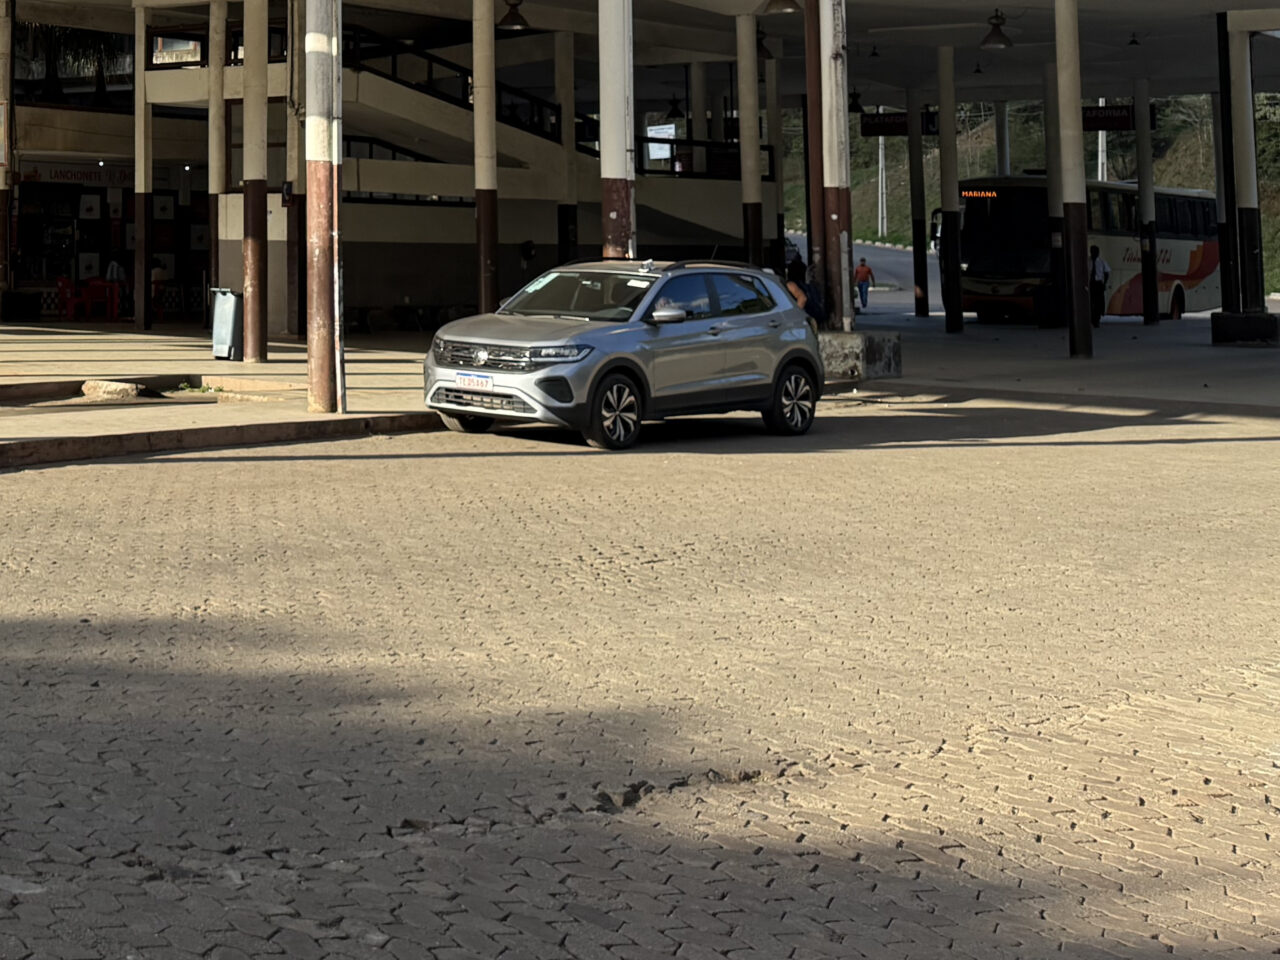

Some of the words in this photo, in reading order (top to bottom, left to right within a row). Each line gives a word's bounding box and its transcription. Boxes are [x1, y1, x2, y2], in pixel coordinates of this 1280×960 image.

[1086, 109, 1129, 118] AFORMA
[49, 168, 102, 182] LANCHONETE
[961, 190, 998, 198] MARIANA
